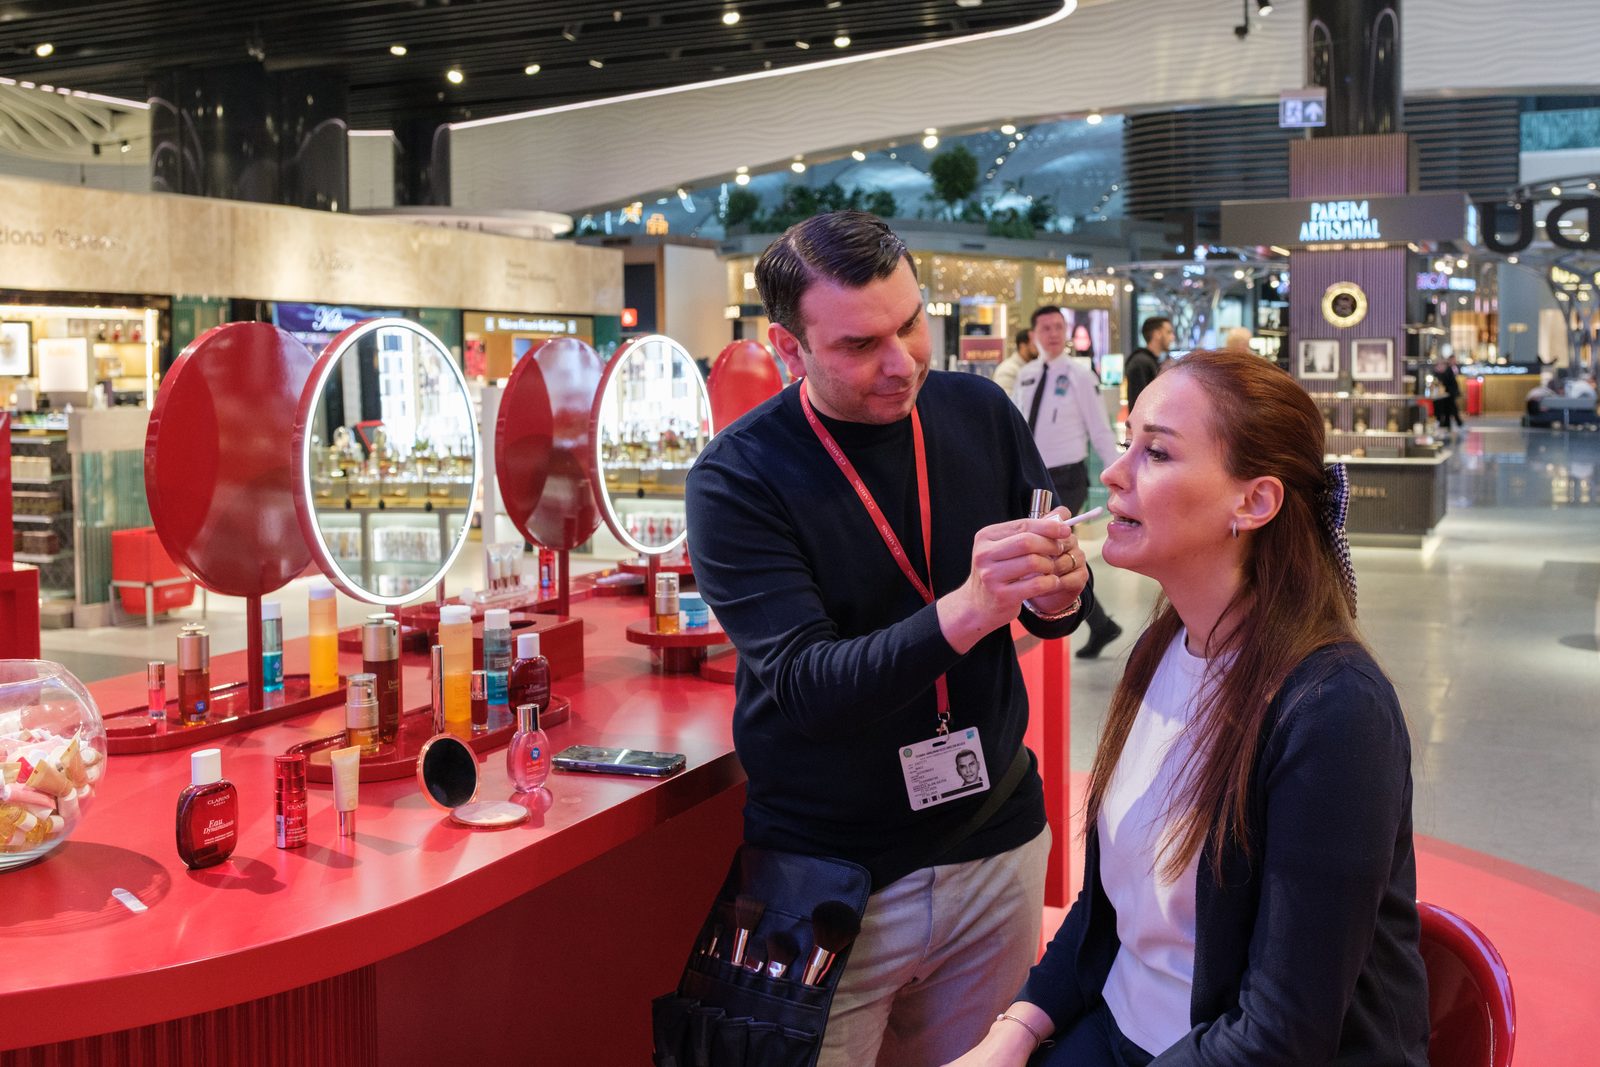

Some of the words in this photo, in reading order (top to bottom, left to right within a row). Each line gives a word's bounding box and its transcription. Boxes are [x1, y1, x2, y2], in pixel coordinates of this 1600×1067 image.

[1299, 218, 1381, 241] ARTISANAL
[824, 436, 848, 467] CLARINS
[854, 479, 876, 511] CLARINS
[881, 524, 901, 556] CLARINS
[207, 794, 230, 805] CLARINS
[208, 819, 223, 829] Eau
